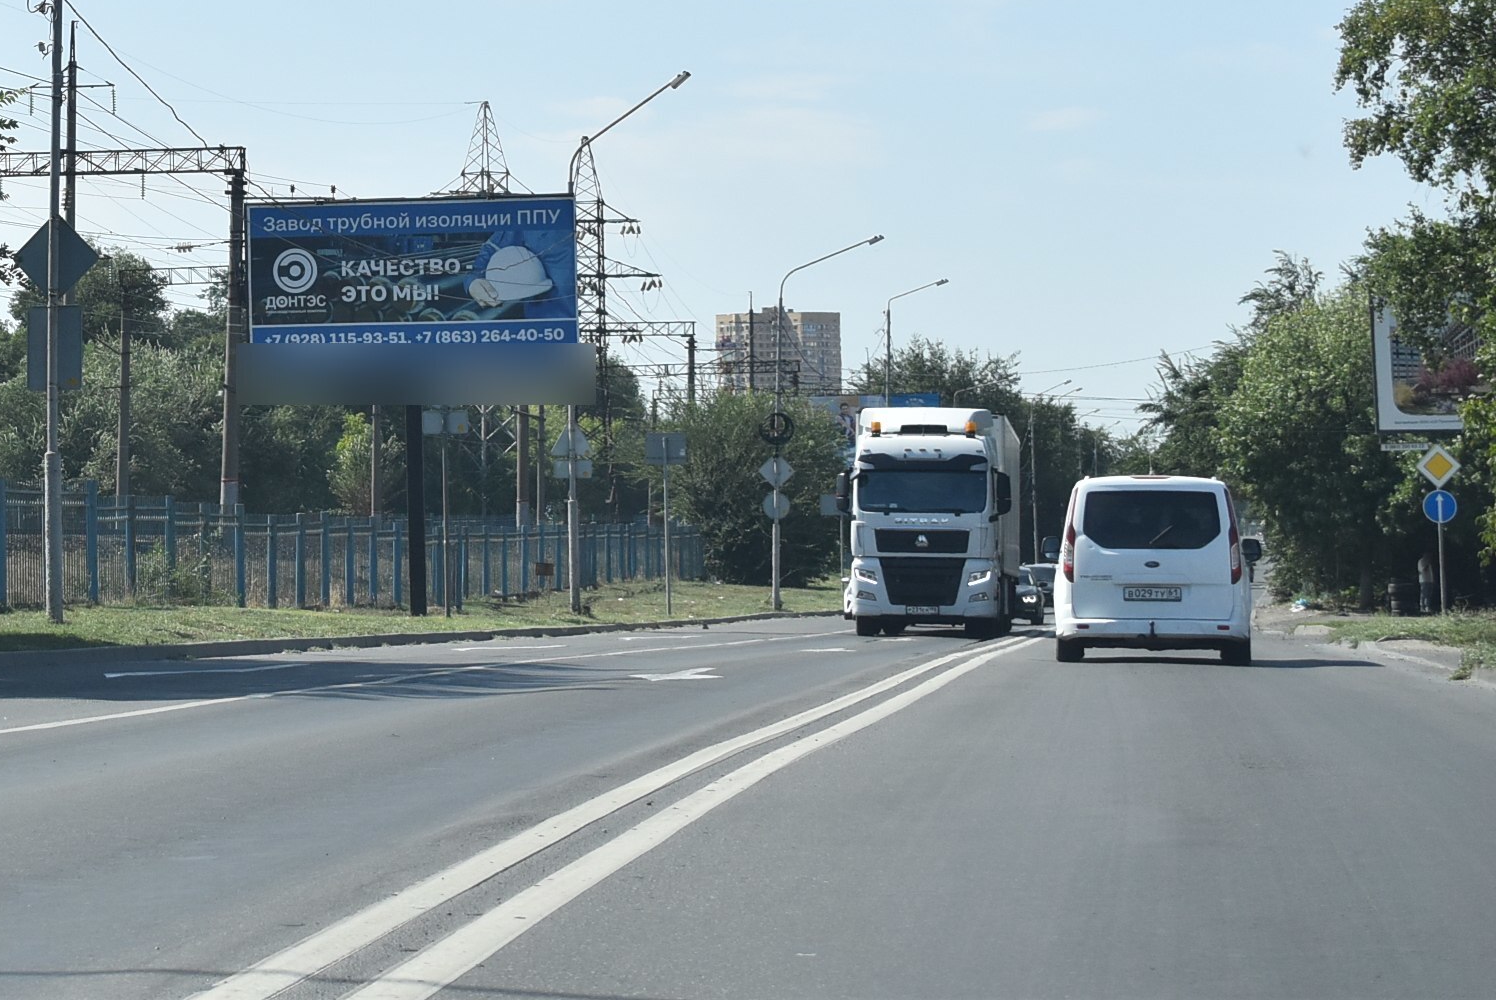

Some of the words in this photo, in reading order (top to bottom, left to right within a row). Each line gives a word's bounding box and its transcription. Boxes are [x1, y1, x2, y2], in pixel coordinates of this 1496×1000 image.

[263, 216, 323, 233] Завод
[327, 212, 410, 233] трубной
[415, 213, 511, 229] изоляции
[517, 209, 561, 225] ППУ
[341, 258, 460, 277] КАЧЕСТВО
[265, 295, 327, 310] ДОНТЭС
[341, 286, 387, 303] ЭТО
[393, 284, 439, 302] МЫ!
[415, 331, 431, 344] +7
[435, 330, 477, 344] (863)
[481, 328, 565, 343] 264-40-50
